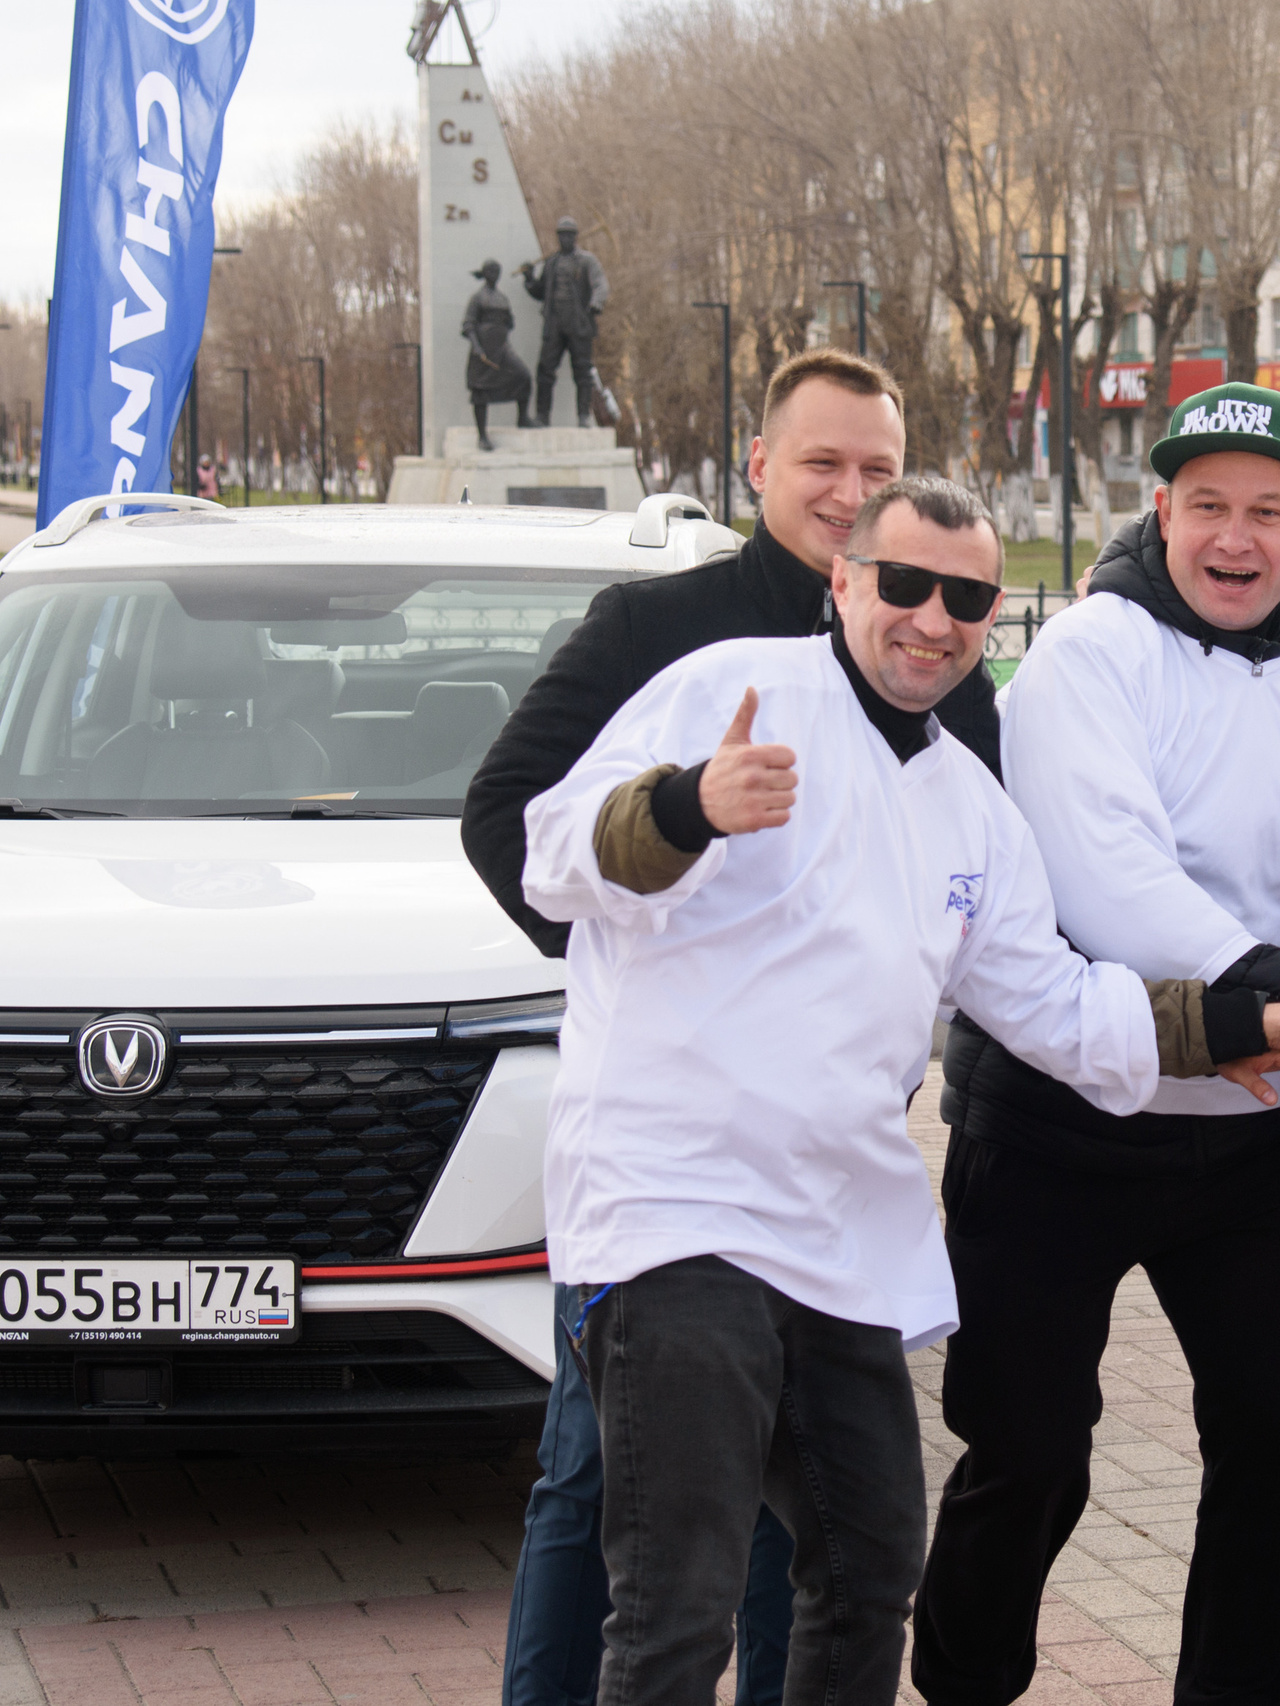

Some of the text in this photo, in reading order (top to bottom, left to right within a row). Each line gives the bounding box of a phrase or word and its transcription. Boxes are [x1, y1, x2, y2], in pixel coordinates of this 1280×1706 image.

[438, 119, 473, 144] Cu
[472, 157, 489, 184] S
[445, 203, 470, 221] Zn
[1211, 398, 1272, 422] JITSU
[195, 1266, 279, 1307] 774
[215, 1310, 256, 1324] RUS
[81, 1331, 108, 1341] (3519)
[109, 1332, 125, 1340] 490
[126, 1332, 142, 1340] 414
[182, 1331, 280, 1341] reginas.changanauto.ru
